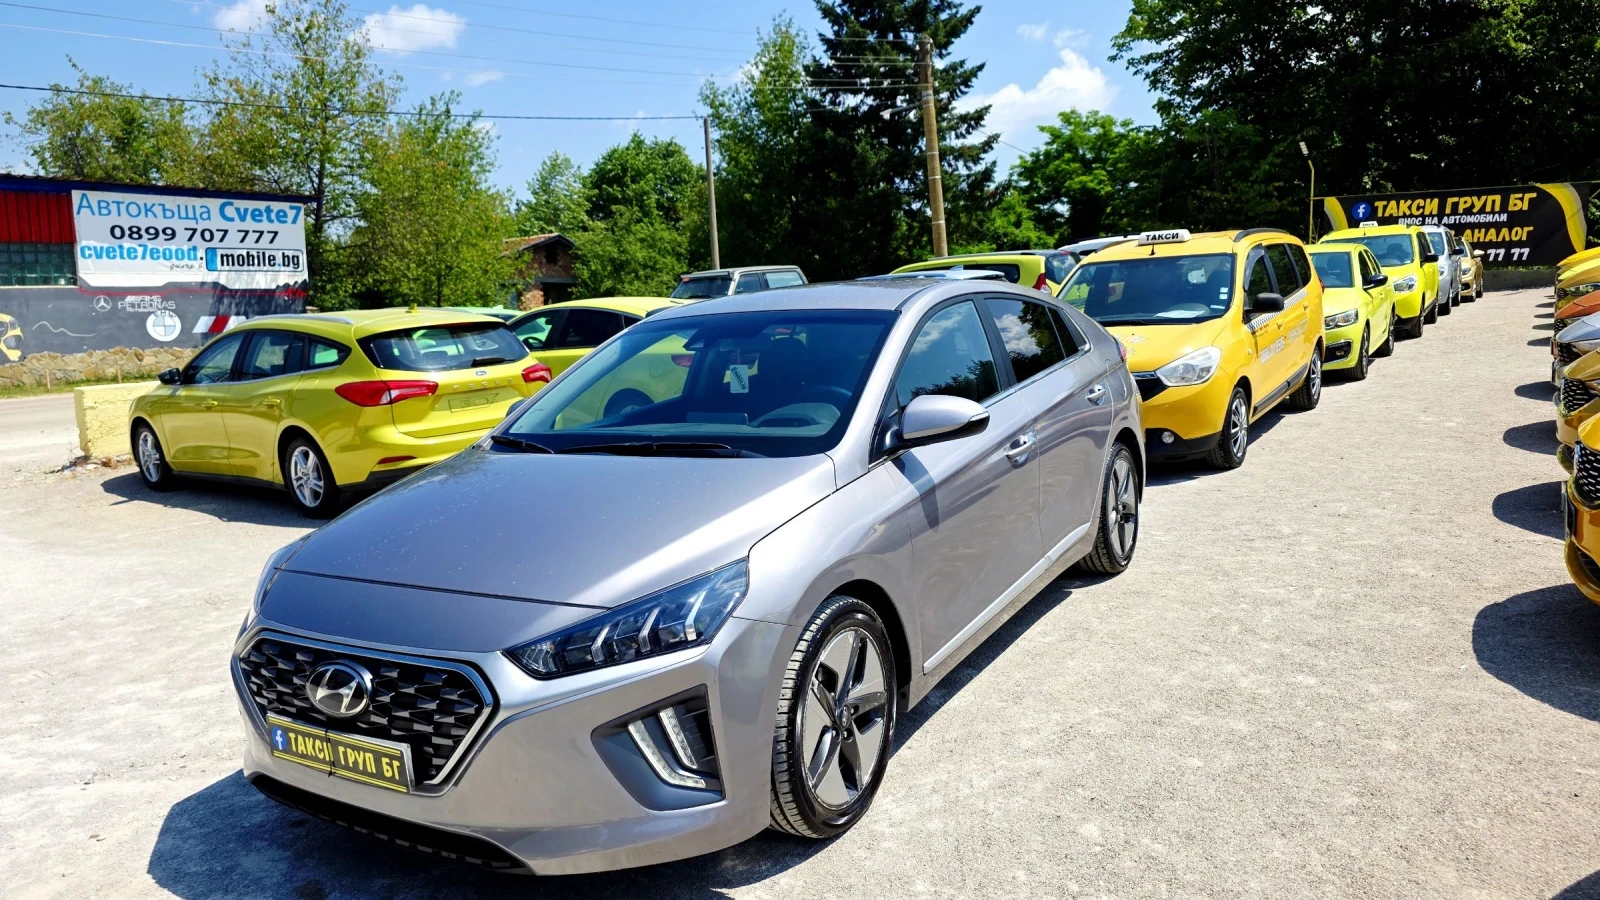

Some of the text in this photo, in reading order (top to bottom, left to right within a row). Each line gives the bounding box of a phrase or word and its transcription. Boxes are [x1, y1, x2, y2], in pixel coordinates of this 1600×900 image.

[76, 192, 303, 226] Автокъща Cvete7
[1374, 198, 1439, 218] ТАКСИ
[1445, 194, 1502, 214] ГРУП
[1508, 193, 1537, 212] БГ
[1397, 213, 1508, 226] ВНОС НА АВТОМОБИЛИ
[109, 224, 280, 245] 0899 707 777
[1145, 232, 1179, 242] ТАКСИ
[1462, 226, 1534, 243] АНАЛОГ
[220, 250, 300, 270] mobile.bg
[1487, 248, 1530, 262] 77 77
[117, 300, 176, 310] PETRONAS
[288, 732, 334, 762] ТАКСИ
[338, 745, 377, 774] ГРУП
[381, 756, 401, 780] БГ
